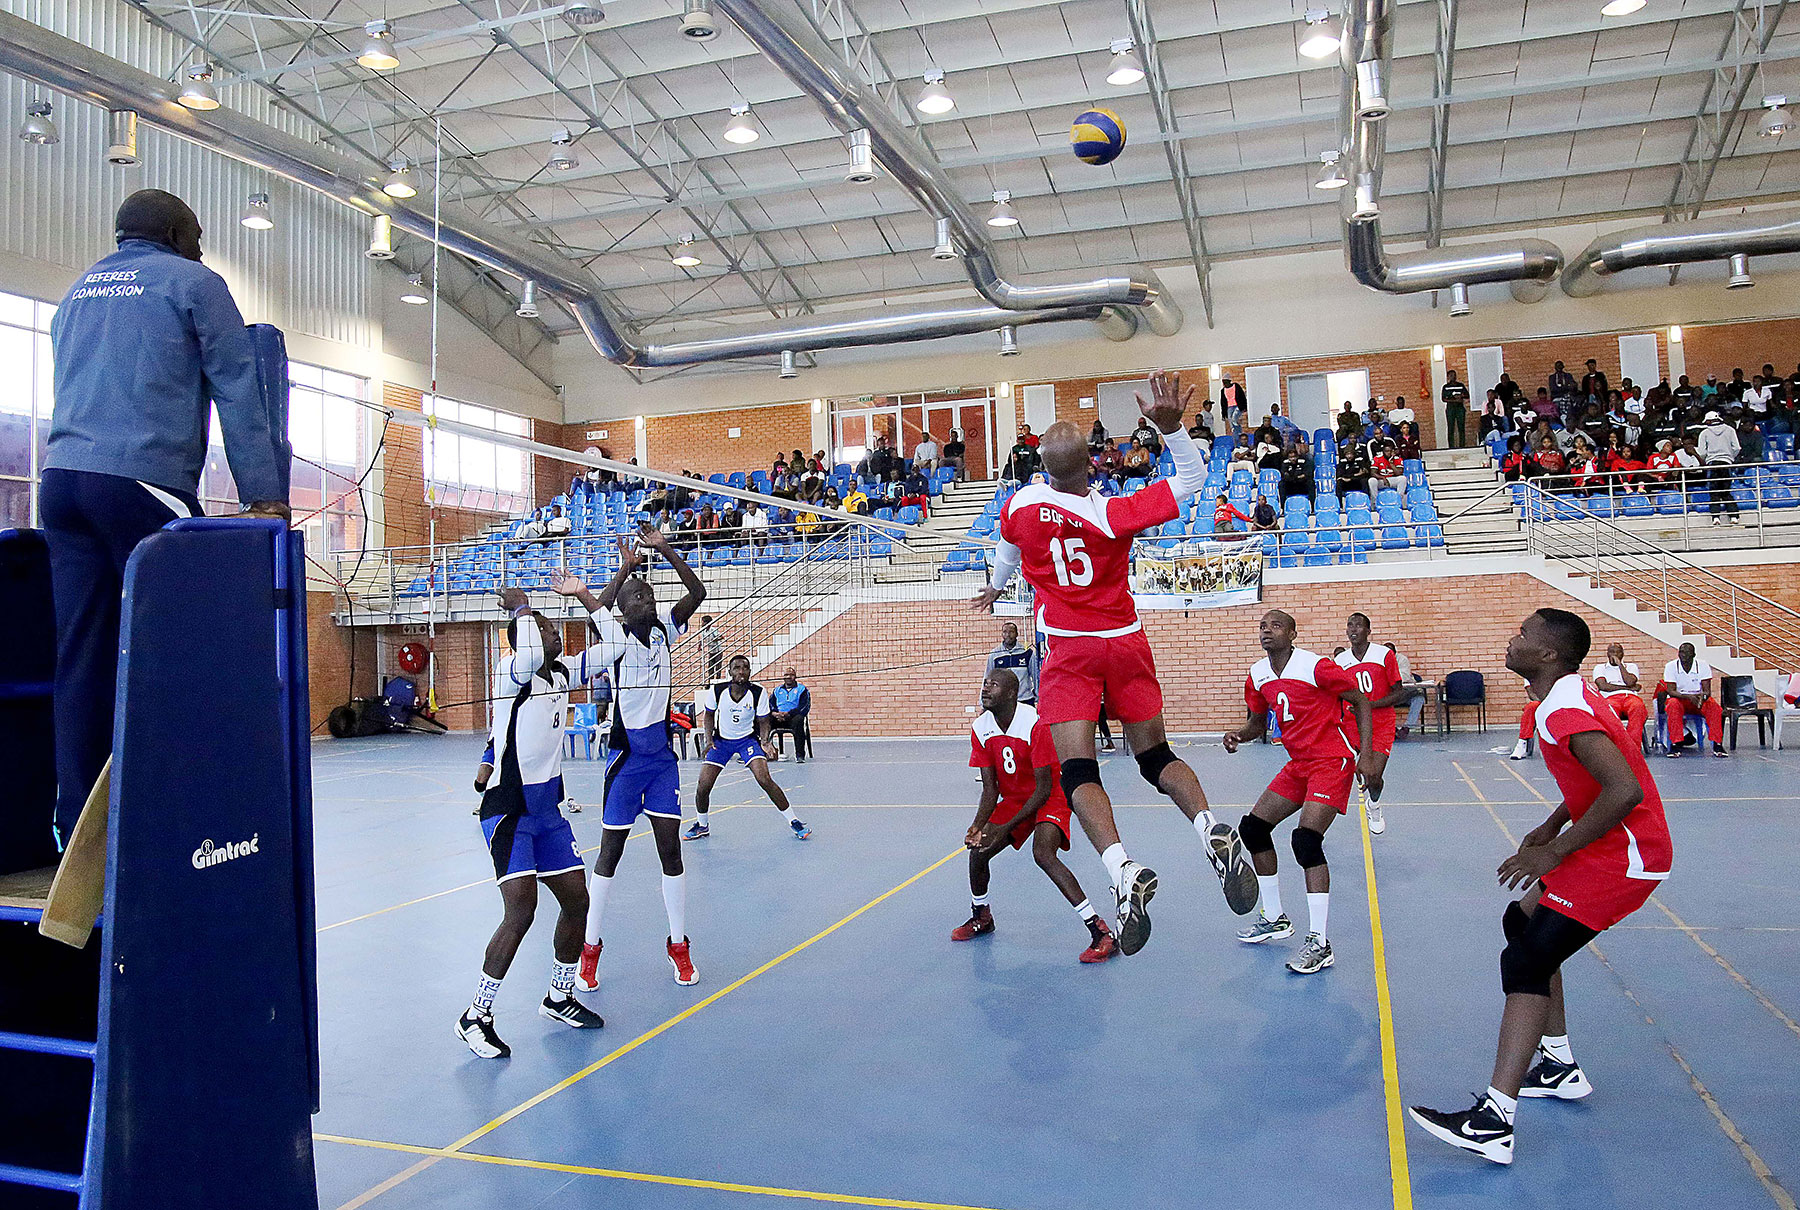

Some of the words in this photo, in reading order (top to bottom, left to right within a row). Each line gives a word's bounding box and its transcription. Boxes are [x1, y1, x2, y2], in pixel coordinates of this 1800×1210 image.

[84, 269, 140, 284] REFEREES
[71, 284, 145, 301] COMMISSION
[1049, 536, 1095, 588] 15
[1355, 670, 1373, 694] 10
[1277, 691, 1295, 722] 2
[552, 711, 560, 729] 8
[732, 714, 740, 723] 5
[747, 746, 754, 756] 5
[1002, 745, 1017, 775] 8
[191, 837, 260, 870] Gimtrac
[570, 841, 581, 858] 8
